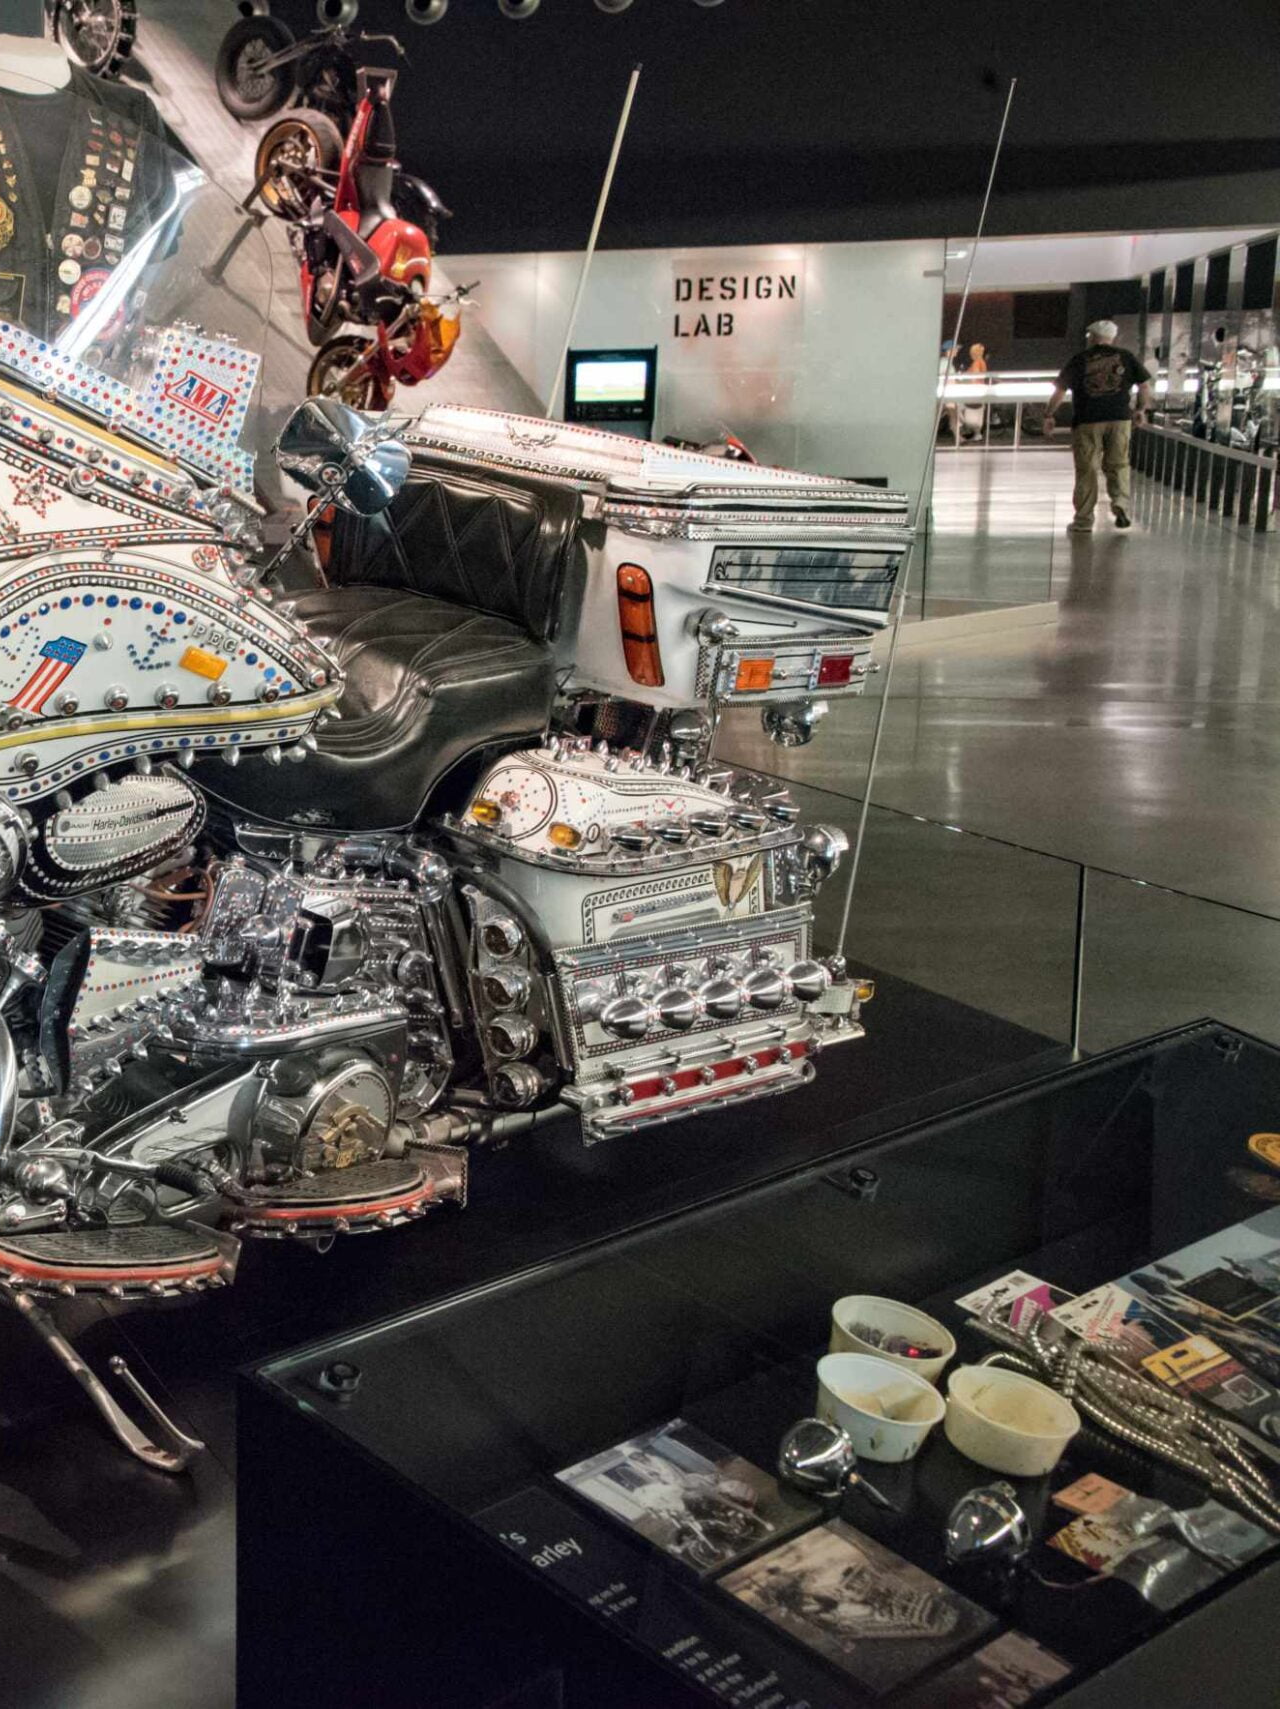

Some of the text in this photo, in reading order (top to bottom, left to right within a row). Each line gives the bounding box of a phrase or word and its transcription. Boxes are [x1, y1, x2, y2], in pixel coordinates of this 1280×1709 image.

[675, 275, 796, 301] DESIGN
[674, 313, 733, 337] LAB
[175, 376, 228, 416] AMA
[192, 623, 238, 653] PEG
[532, 1538, 583, 1567] arley
